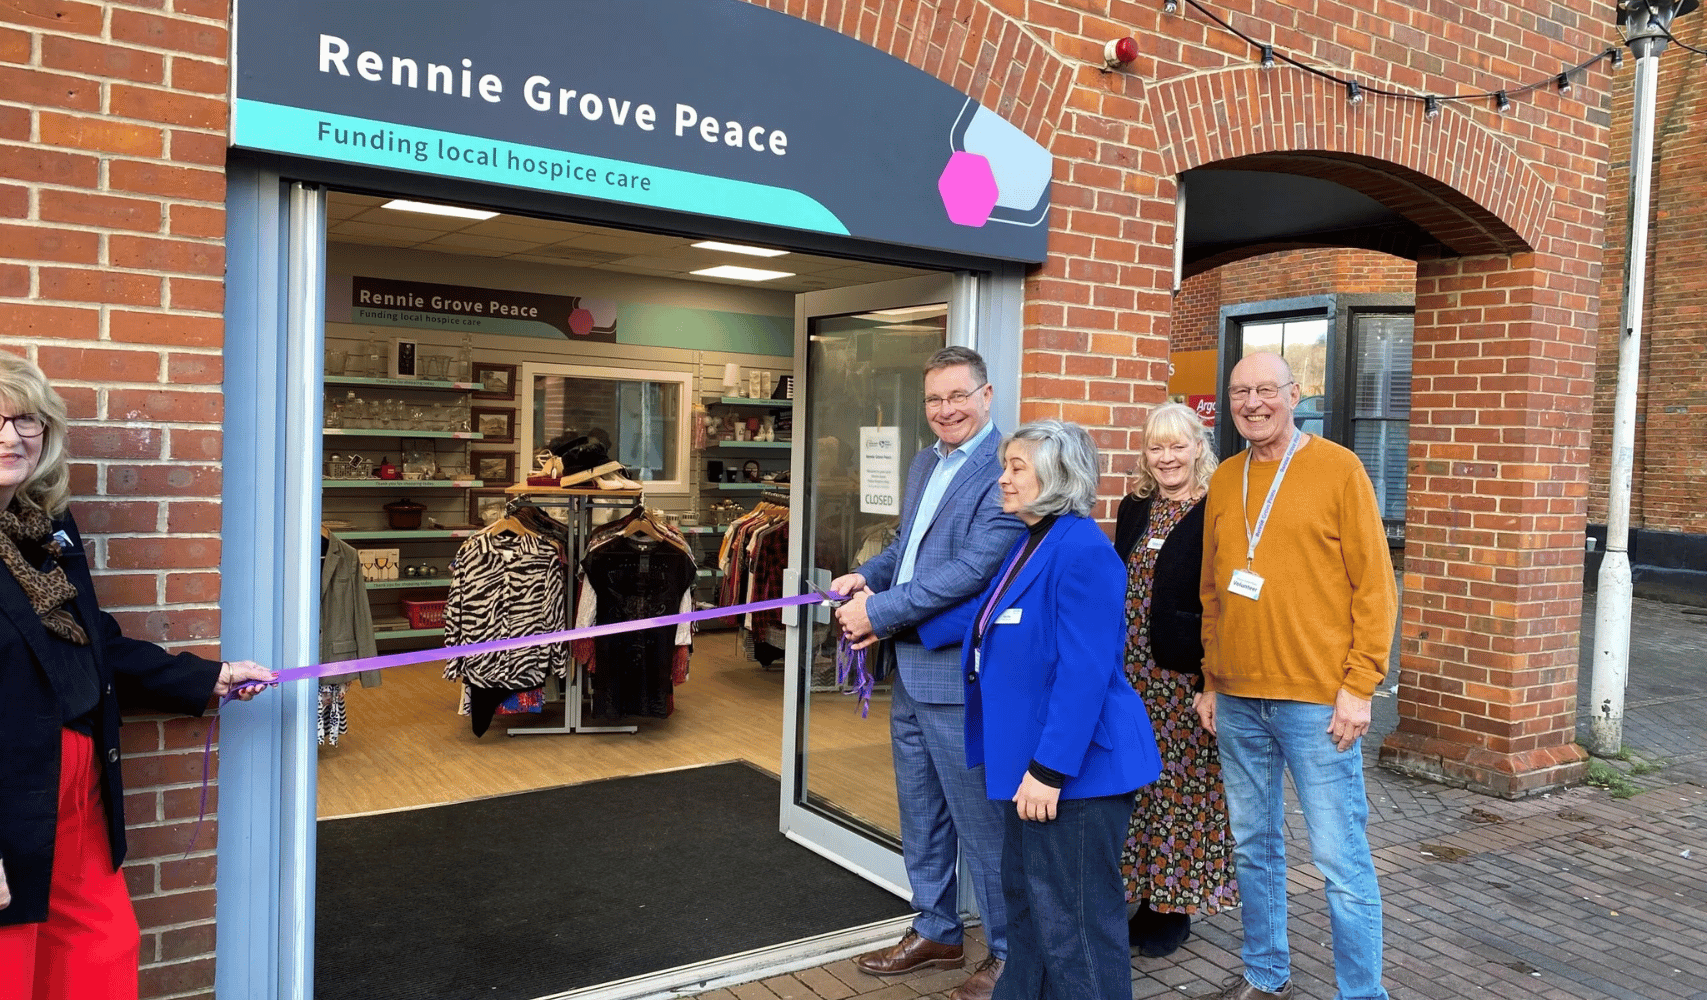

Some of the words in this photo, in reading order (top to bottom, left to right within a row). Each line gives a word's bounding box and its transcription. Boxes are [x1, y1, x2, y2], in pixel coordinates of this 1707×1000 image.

[318, 33, 503, 103] Rennie
[523, 75, 657, 132] Grove
[675, 103, 788, 157] Peace
[317, 121, 429, 163] Funding
[438, 139, 498, 168] local
[507, 150, 597, 185] hospice
[605, 170, 652, 192] care
[359, 309, 399, 322] Funding
[400, 312, 423, 322] local
[425, 314, 460, 327] hospice
[462, 318, 482, 327] care
[360, 290, 424, 308] Rennie
[431, 295, 484, 314] Grove
[490, 302, 538, 318] Peace
[865, 494, 893, 506] CLOSED
[1255, 519, 1264, 537] Rennie
[1262, 505, 1271, 519] Grove
[1233, 580, 1258, 592] Volunteer
